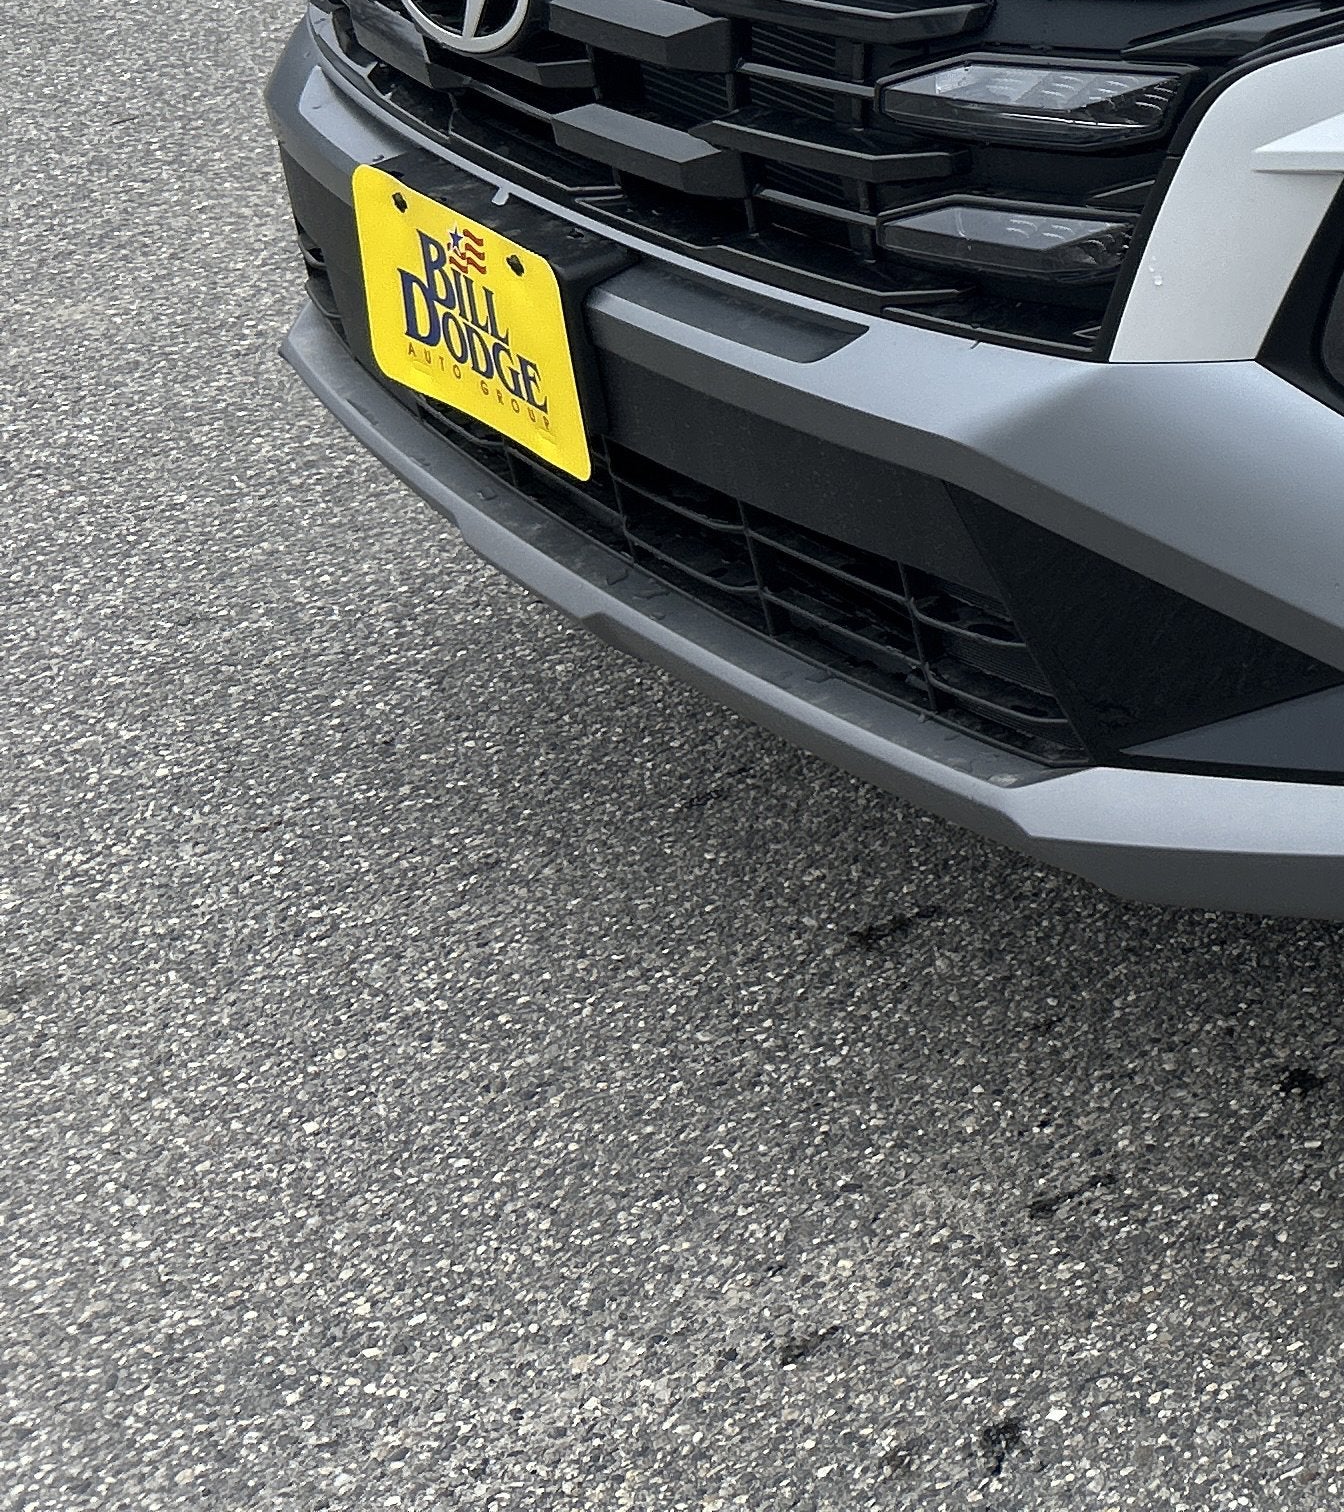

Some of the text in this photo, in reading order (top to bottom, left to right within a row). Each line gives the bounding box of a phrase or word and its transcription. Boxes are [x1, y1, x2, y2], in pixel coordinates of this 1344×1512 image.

[397, 267, 550, 415] DODGE
[415, 227, 510, 345] BILL
[407, 343, 551, 431] AUTO GROUP
